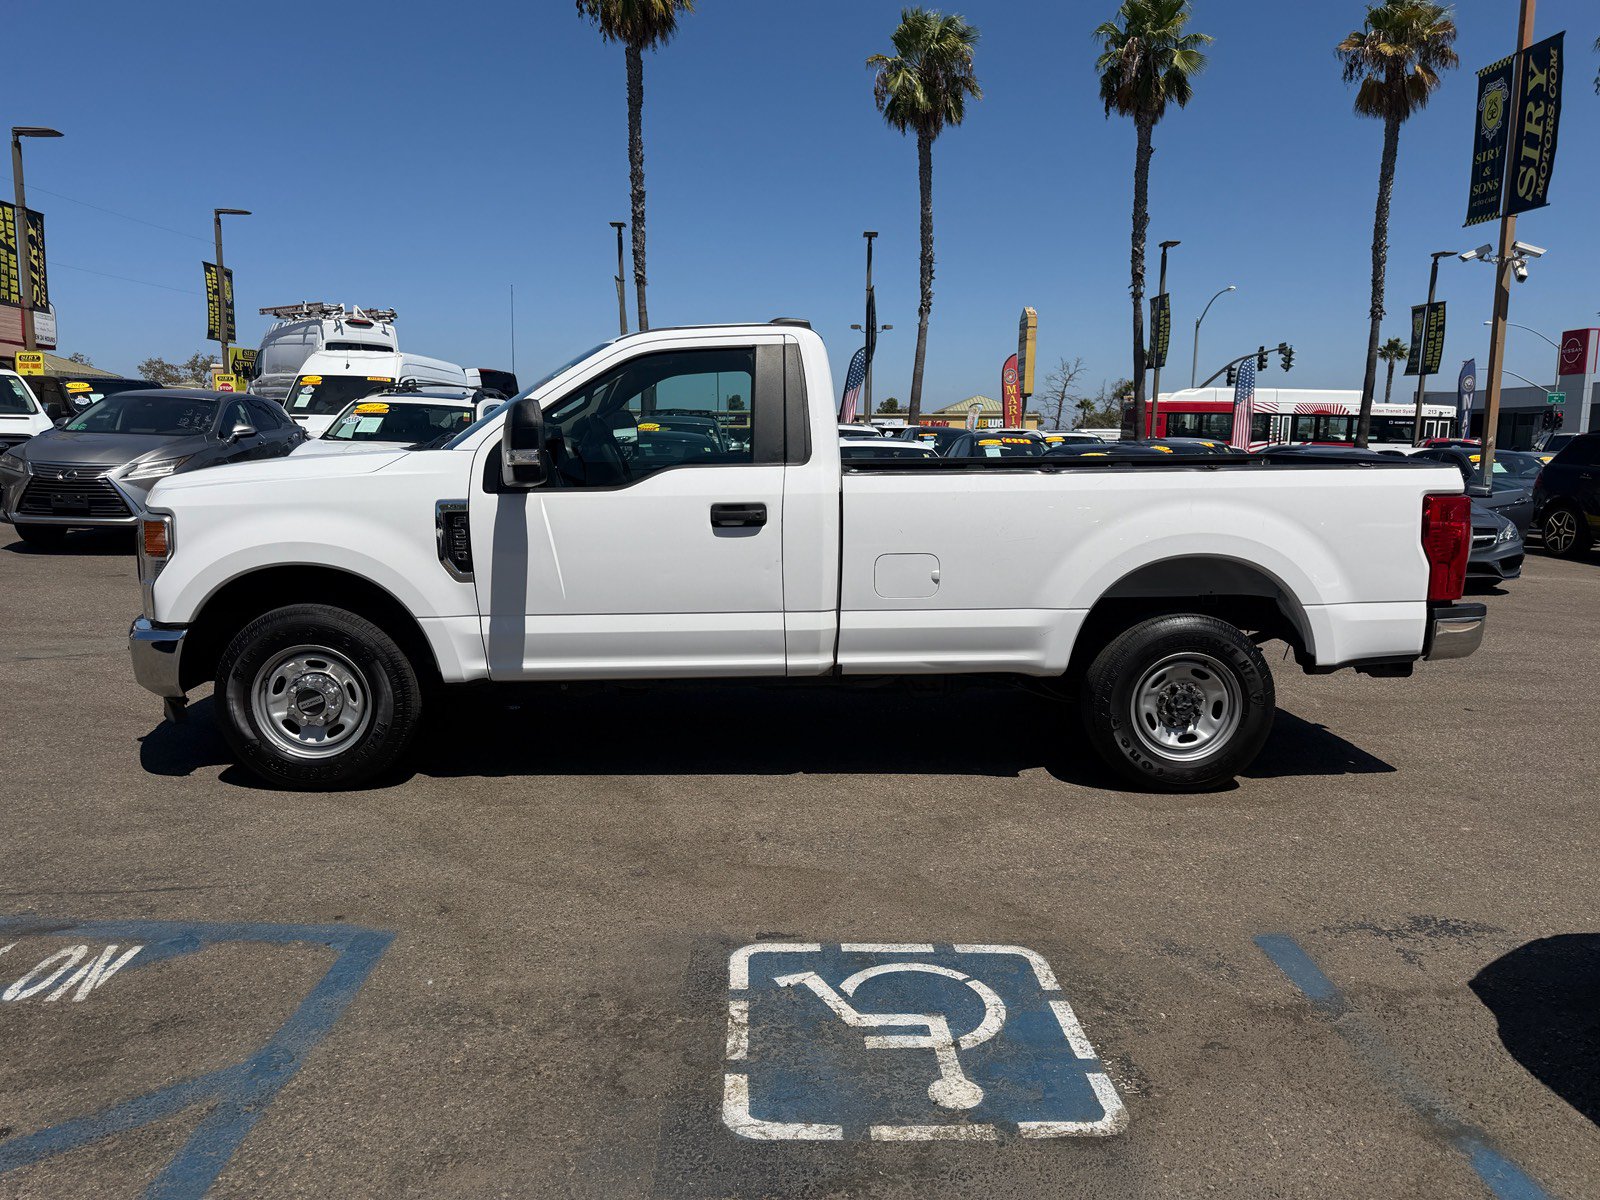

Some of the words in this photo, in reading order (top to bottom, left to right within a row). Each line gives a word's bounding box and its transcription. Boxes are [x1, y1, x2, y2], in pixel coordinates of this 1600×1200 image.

[1517, 55, 1547, 202] SIRY
[1536, 46, 1558, 199] MOTORS.COM
[1475, 145, 1501, 165] SIRY
[1483, 166, 1492, 177] &
[1472, 178, 1500, 197] SONS
[4, 206, 16, 250] BUY
[9, 253, 20, 304] HERE
[205, 271, 214, 300] AUTO
[210, 266, 218, 290] FULL
[1428, 312, 1437, 339] AUTO
[1437, 304, 1445, 327] FULL
[1425, 341, 1435, 366] CARE
[1430, 331, 1444, 373] SERVICE
[1462, 393, 1474, 438] NA
